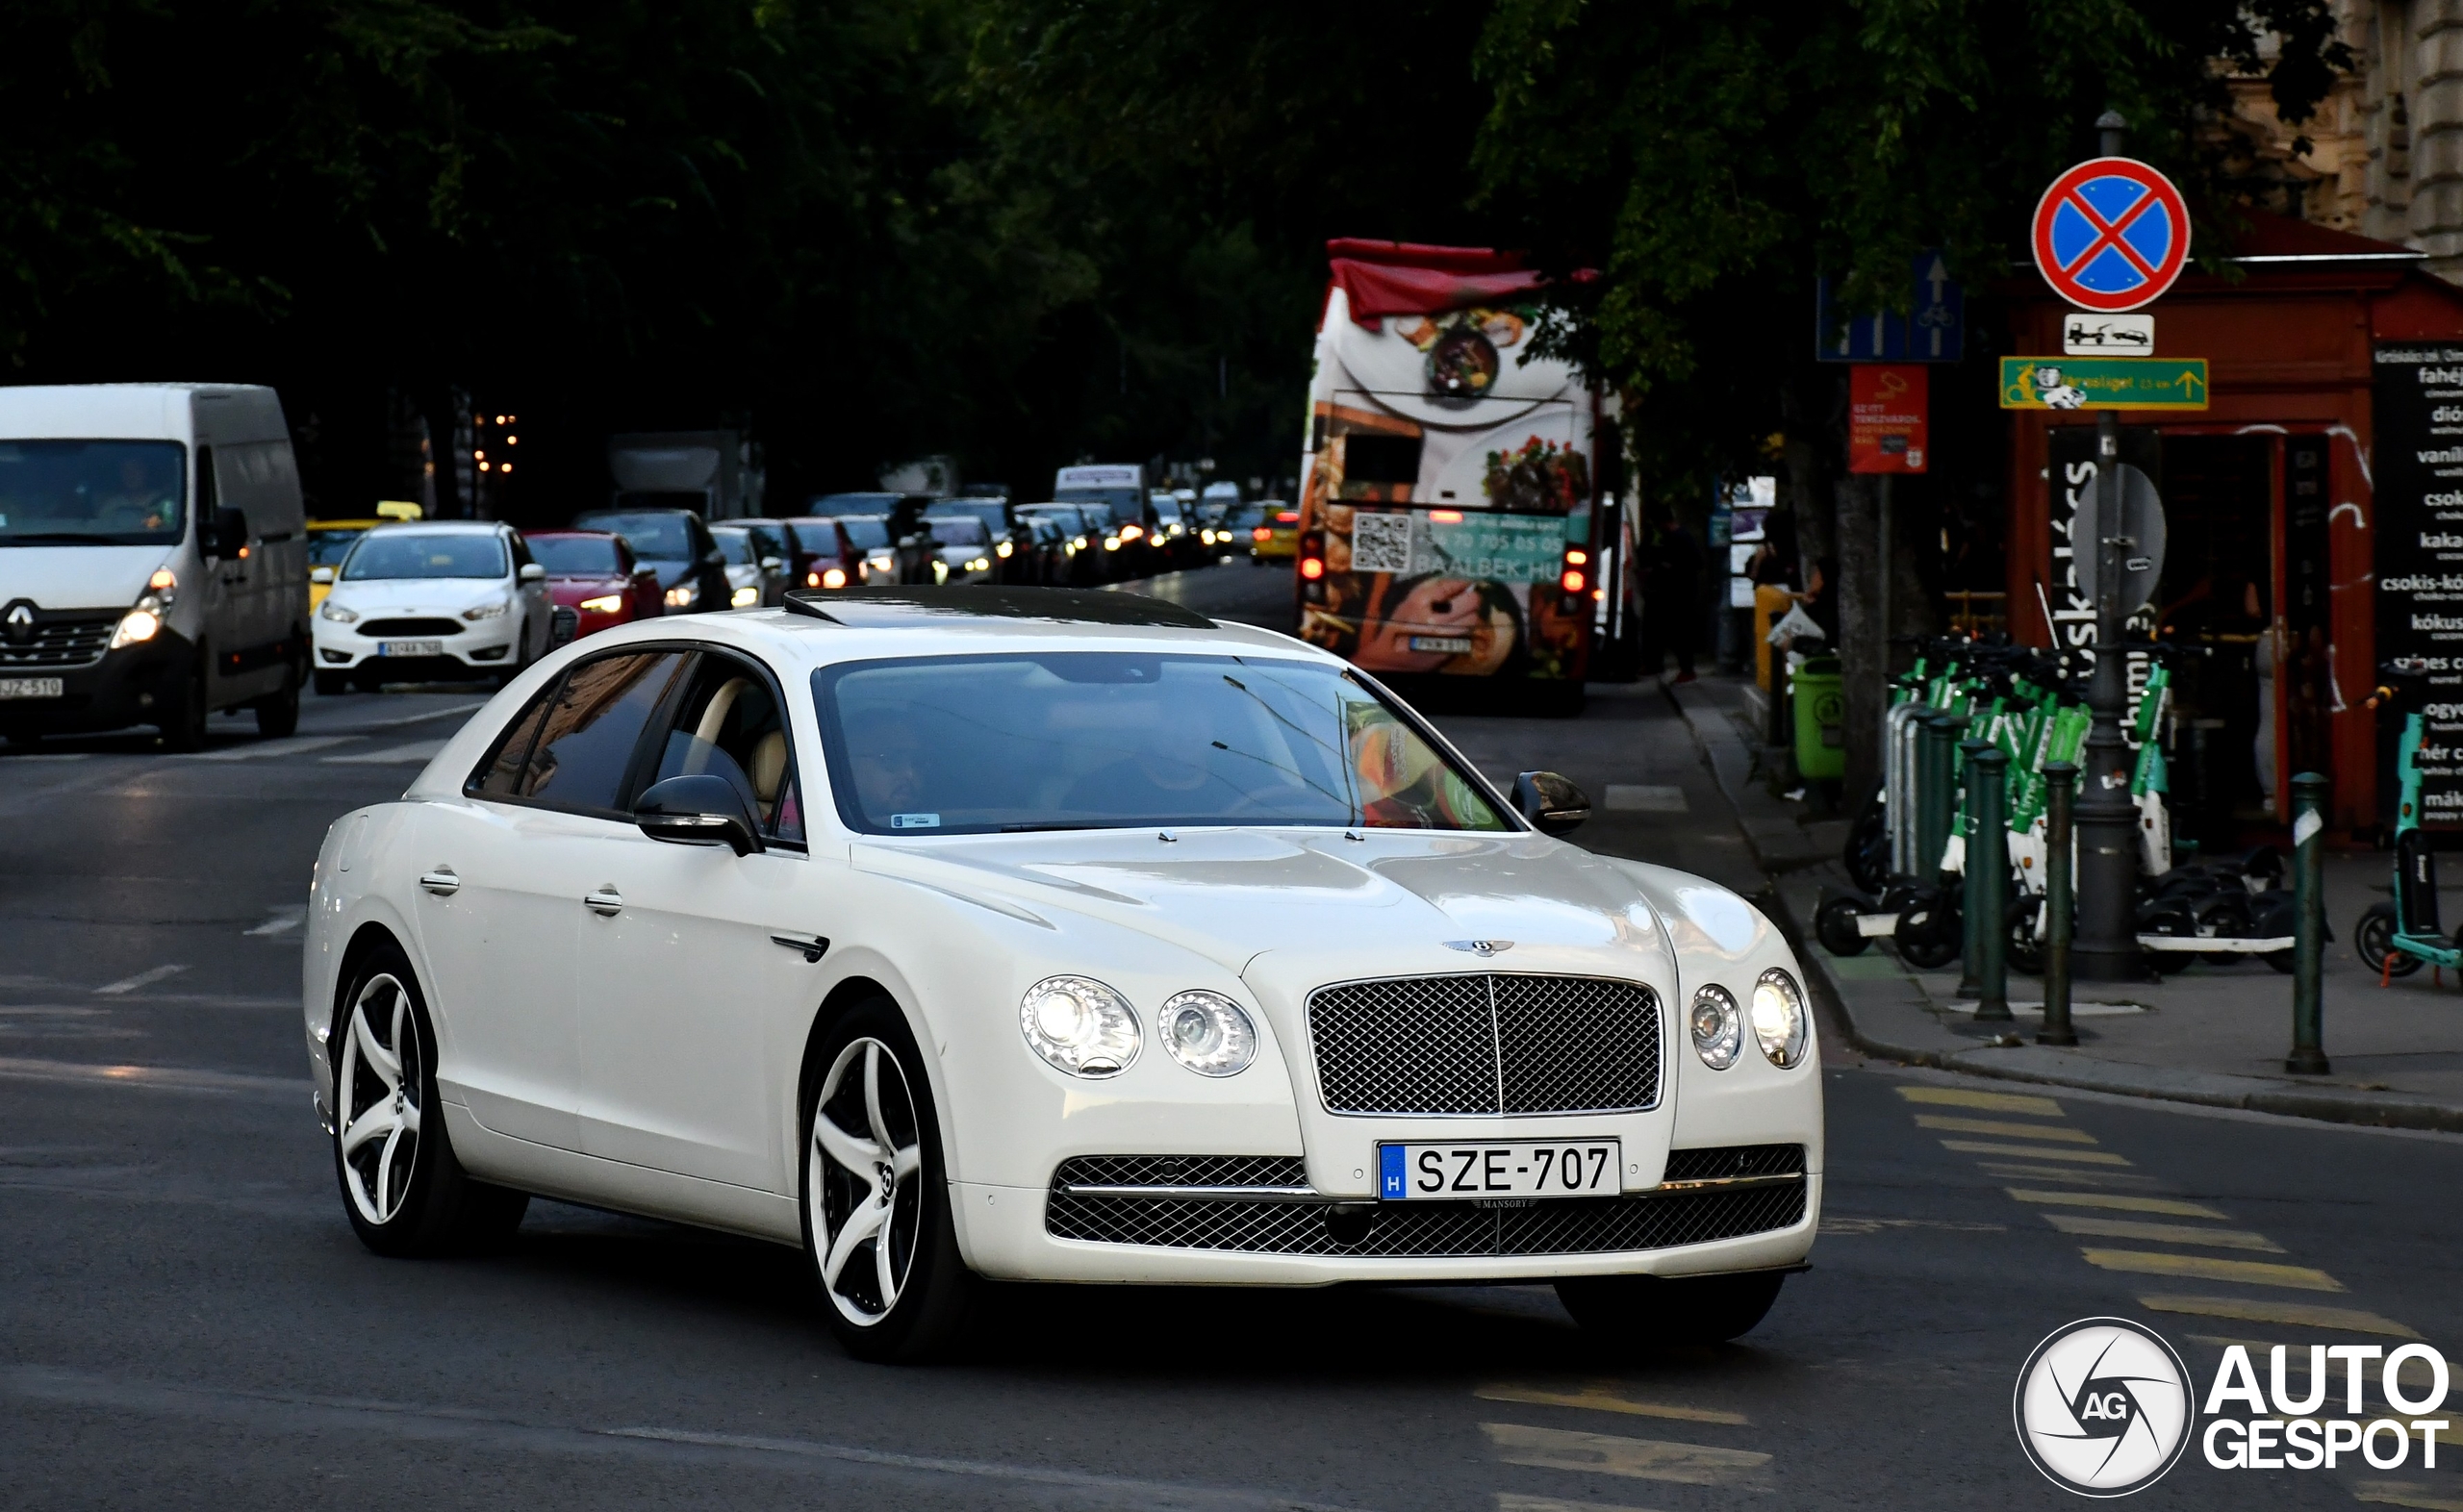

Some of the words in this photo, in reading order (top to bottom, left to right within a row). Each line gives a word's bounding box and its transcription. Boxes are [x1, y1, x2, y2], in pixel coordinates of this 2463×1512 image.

[1387, 1176, 1400, 1192] H
[1417, 1147, 1608, 1193] SZE-707
[1483, 1198, 1528, 1209] MANSORY
